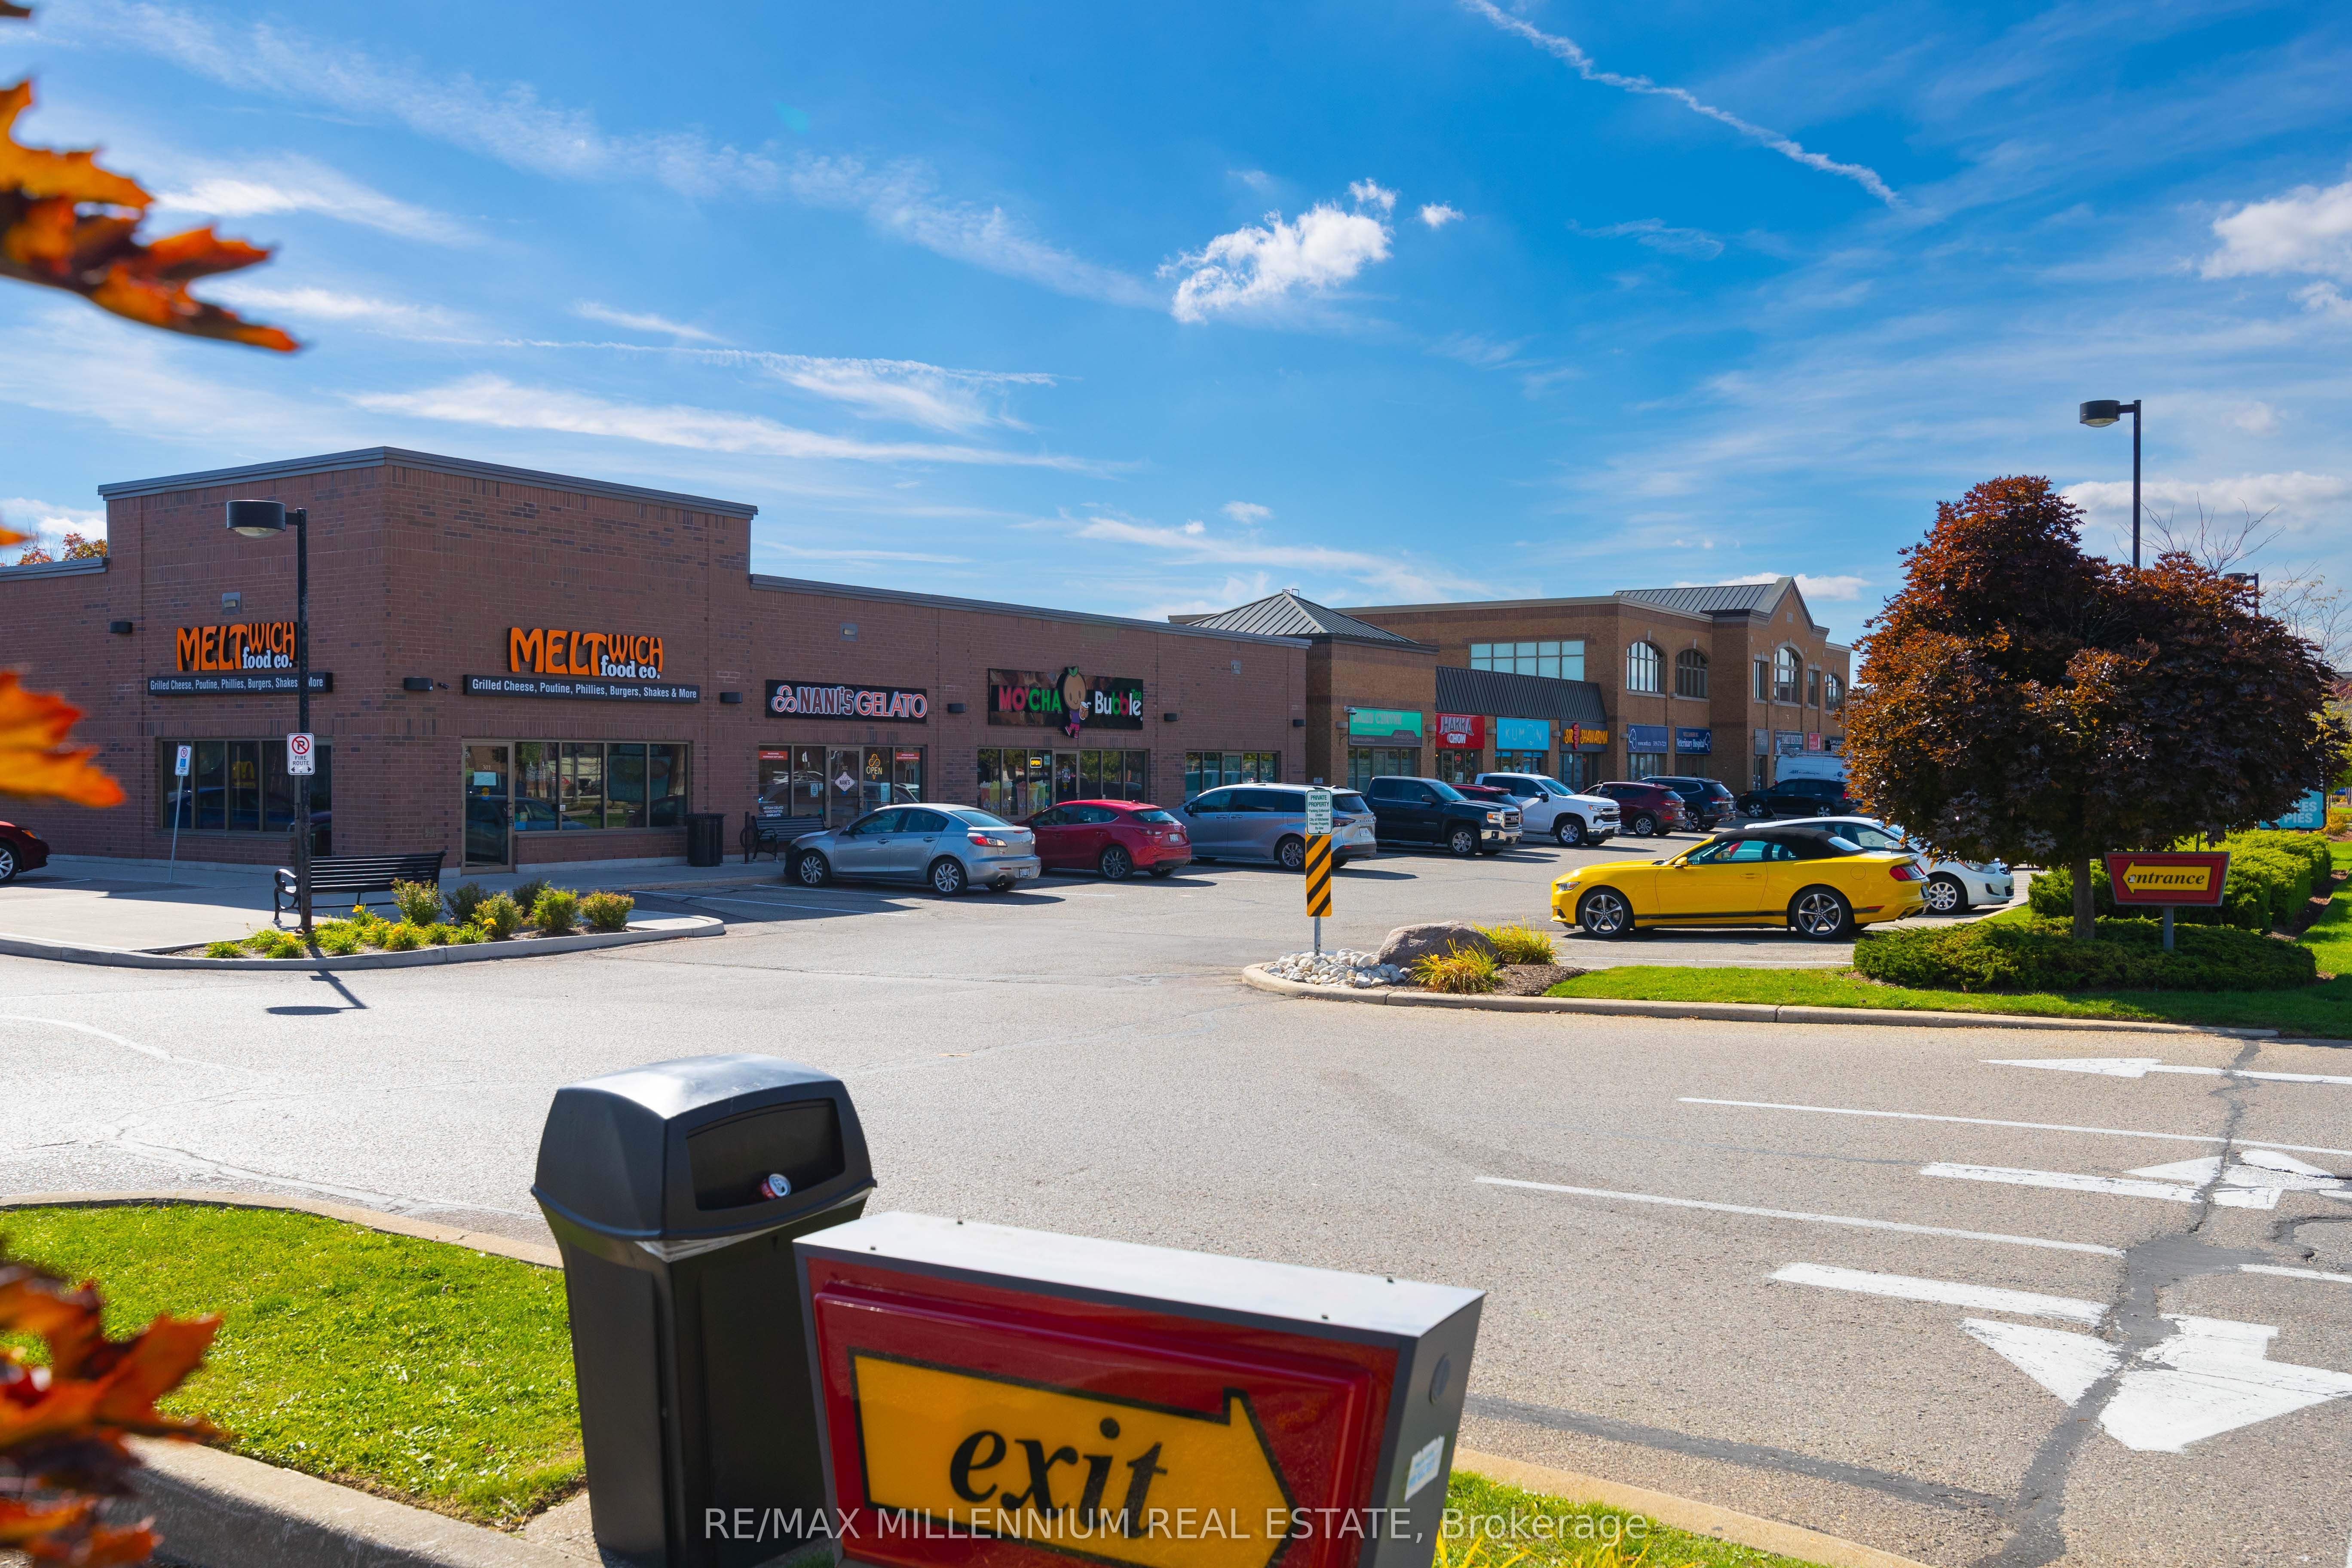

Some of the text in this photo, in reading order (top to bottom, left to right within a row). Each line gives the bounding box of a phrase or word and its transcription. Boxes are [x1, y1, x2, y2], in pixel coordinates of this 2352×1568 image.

[177, 622, 295, 671] MELTWICH
[508, 627, 664, 677] MELTWICH
[242, 646, 292, 669] food co.
[600, 655, 661, 680] food co.
[150, 680, 169, 690] Grilled
[171, 680, 193, 690] Cheese,
[196, 679, 219, 690] Poutine,
[221, 679, 246, 689] Phillies,
[248, 678, 274, 690] Burgers,
[276, 677, 298, 688] Shakes
[472, 679, 697, 698] Grilled Cheese, Poutine, Phillies, Burgers, Shakes & More
[797, 686, 928, 718] NANI'S GELATO
[1095, 691, 1142, 716] Bubble
[1131, 689, 1142, 700] Tea
[1375, 713, 1402, 725] CENTRE
[1439, 716, 1474, 736] HAKKA
[1447, 733, 1466, 744] CHOW
[1564, 728, 1608, 744] SIR SHAWARMA
[866, 766, 882, 775] OPEN
[2284, 812, 2313, 824] PIES
[2127, 872, 2205, 885] entrance
[950, 1417, 1168, 1538] exit
